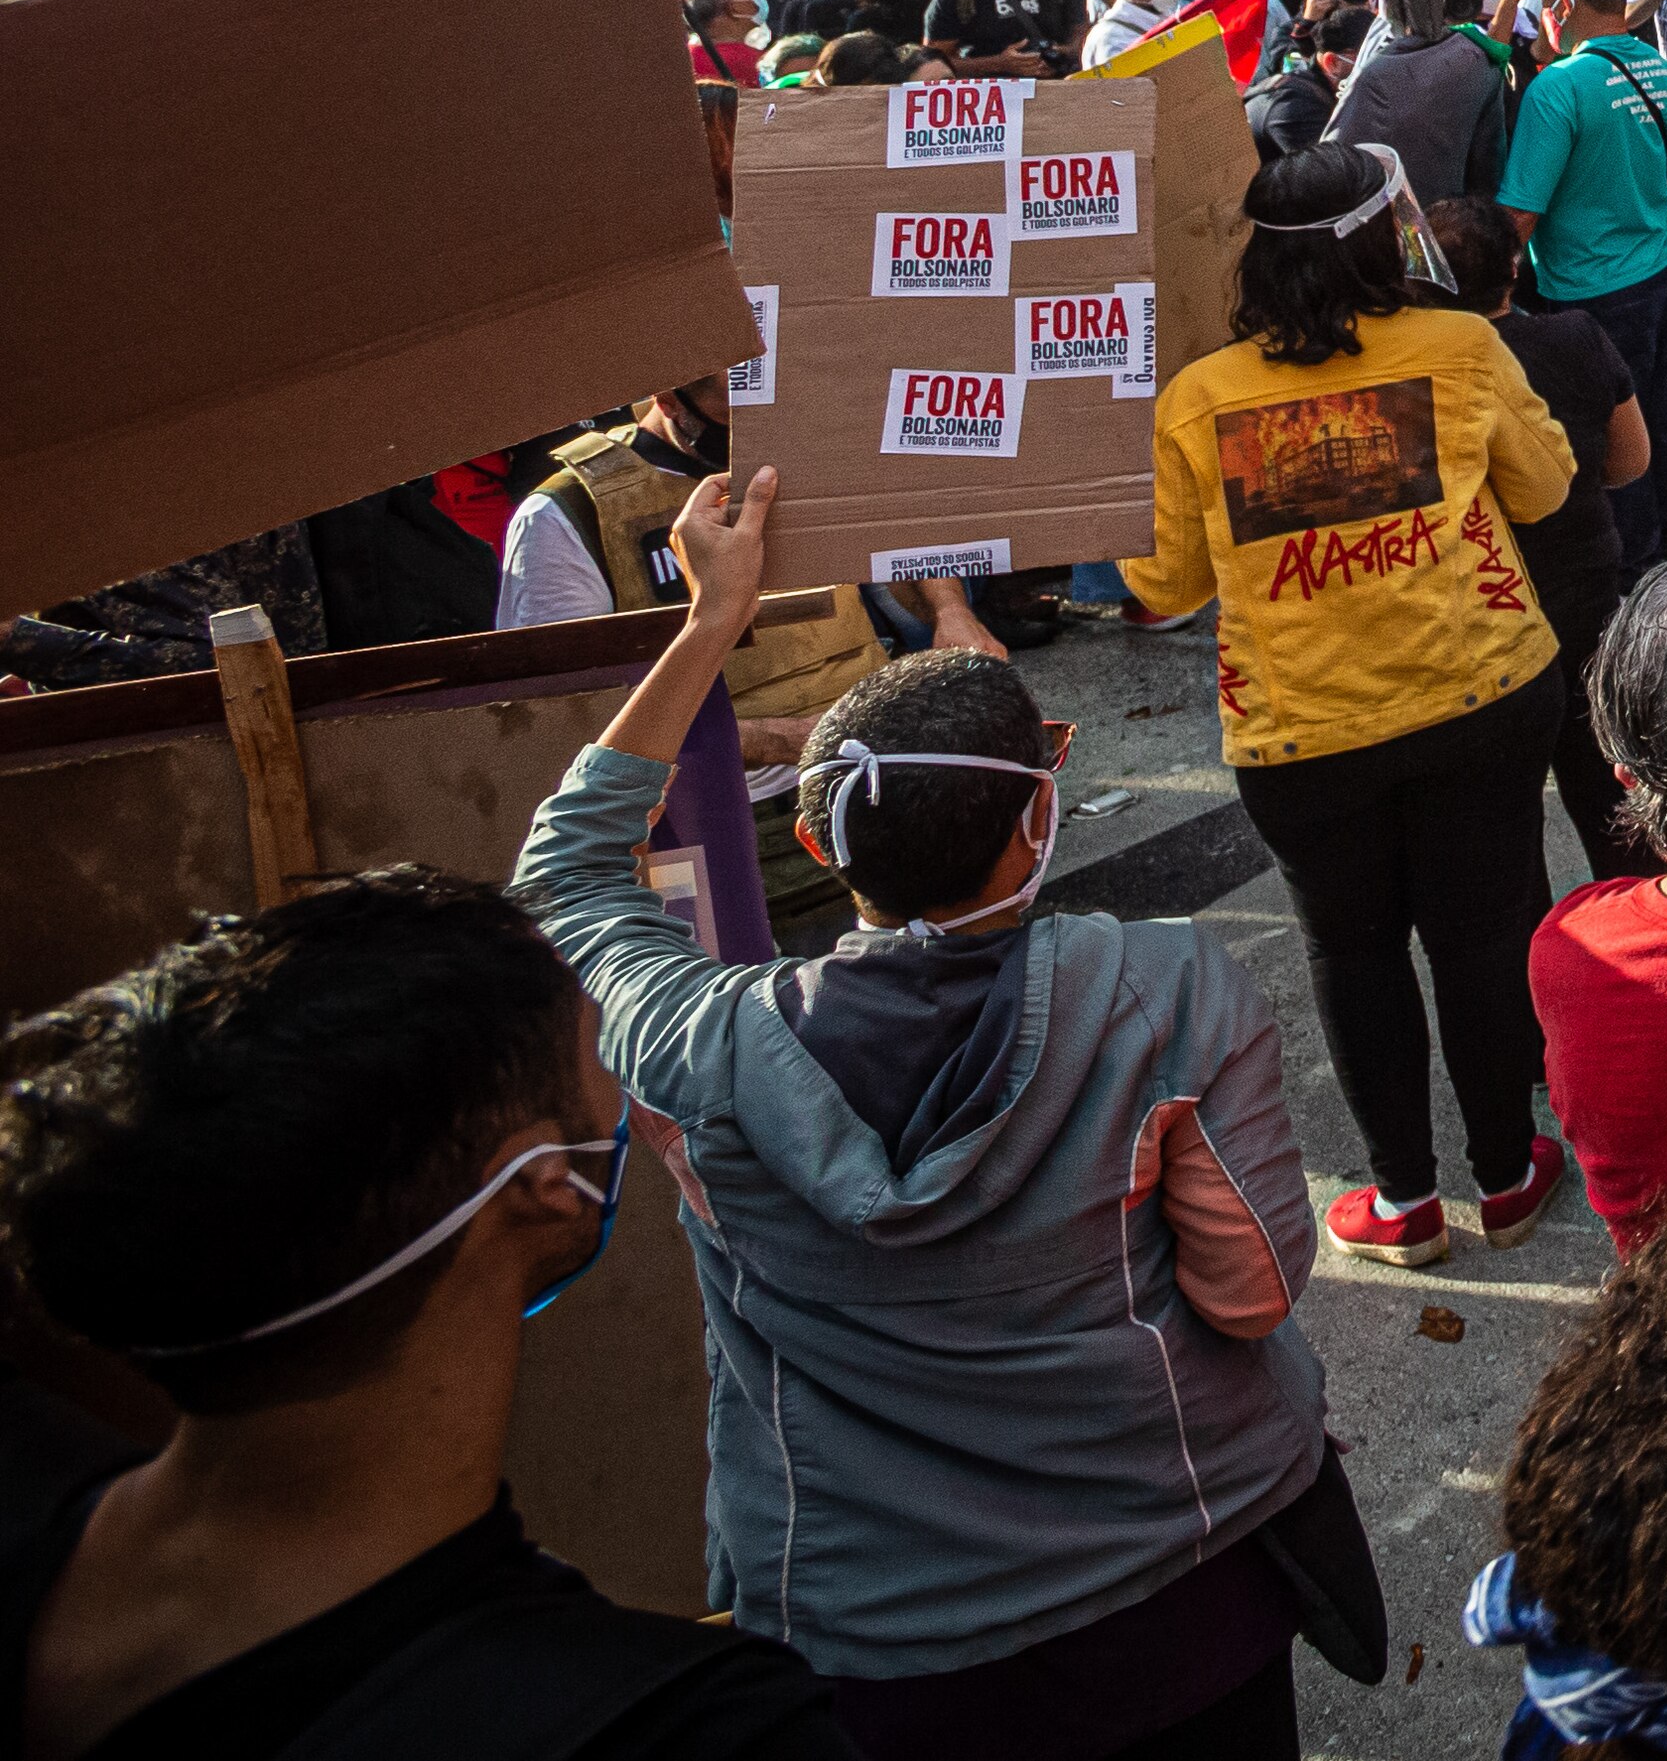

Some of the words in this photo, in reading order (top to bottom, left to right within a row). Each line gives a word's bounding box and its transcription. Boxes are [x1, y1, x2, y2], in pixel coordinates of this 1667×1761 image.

[905, 86, 1006, 129] FORA
[905, 125, 1005, 148] BOLSONARO
[904, 149, 910, 159] E
[912, 146, 941, 158] TODOS
[943, 145, 955, 156] OS
[956, 142, 1005, 155] GOLPISTAS
[1020, 156, 1120, 201] FORA
[1022, 196, 1119, 219] BOLSONARO
[1022, 220, 1028, 230] E
[1030, 218, 1058, 229] TODOS
[1060, 216, 1071, 228] OS
[1072, 214, 1119, 226] GOLPISTAS
[891, 217, 994, 259] FORA
[891, 259, 992, 277] BOLSONARO
[889, 277, 896, 287] E
[898, 277, 927, 287] TODOS
[929, 277, 940, 287] OS
[941, 277, 991, 287] GOLPISTAS
[1030, 297, 1129, 341] FORA
[1031, 338, 1128, 359] BOLSONARO
[1030, 361, 1037, 371] E
[1038, 359, 1068, 371] TODOS
[1069, 358, 1079, 369] OS
[1081, 356, 1128, 368] GOLPISTAS
[903, 375, 1006, 418] FORA
[901, 416, 1002, 437] BOLSONARO
[899, 435, 905, 445] E
[907, 435, 936, 447] TODOS
[938, 436, 949, 447] OS
[951, 437, 1000, 448] GOLPISTAS
[891, 557, 941, 570] GOLPISTAS
[943, 555, 955, 565] OS
[956, 551, 985, 563] TODOS
[1269, 508, 1449, 602] ALASTRA
